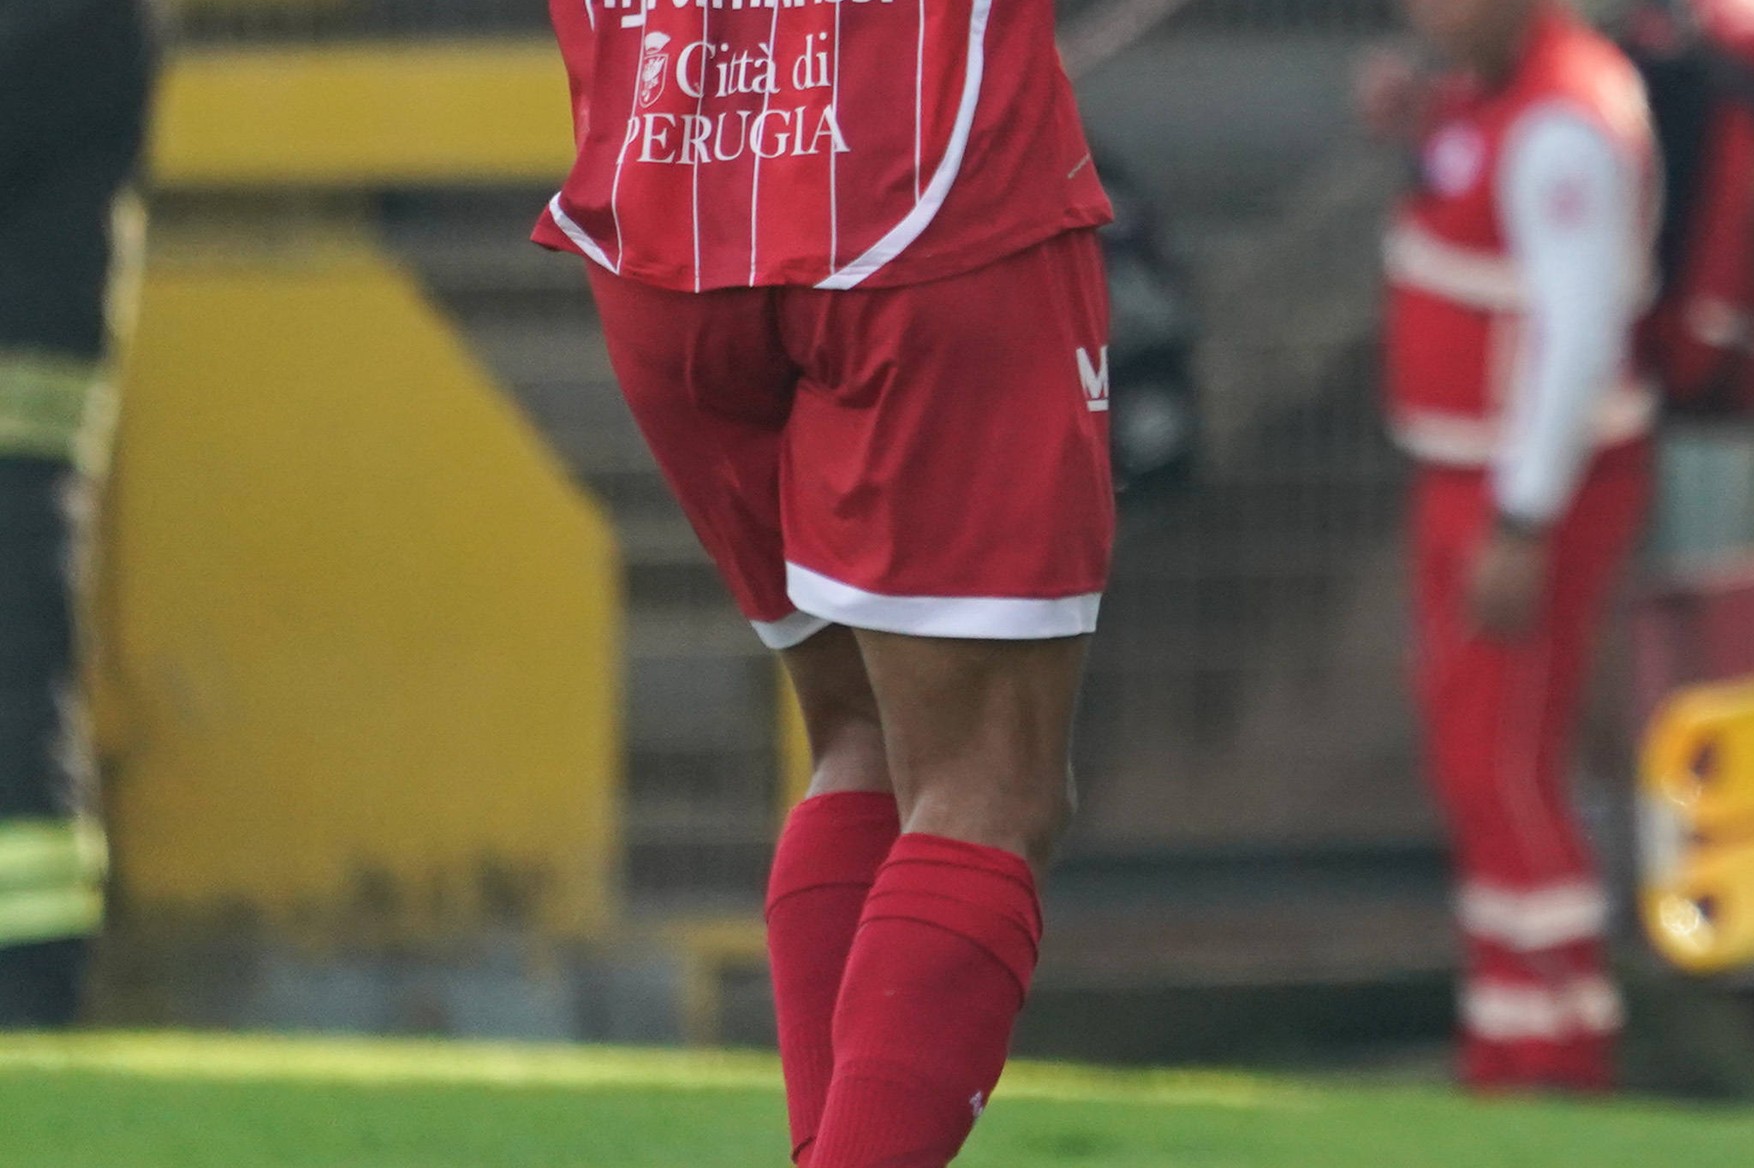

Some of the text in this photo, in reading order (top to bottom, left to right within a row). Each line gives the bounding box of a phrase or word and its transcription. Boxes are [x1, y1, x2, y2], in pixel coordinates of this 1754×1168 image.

[675, 31, 832, 99] Città di
[616, 103, 851, 165] PERUGIA
